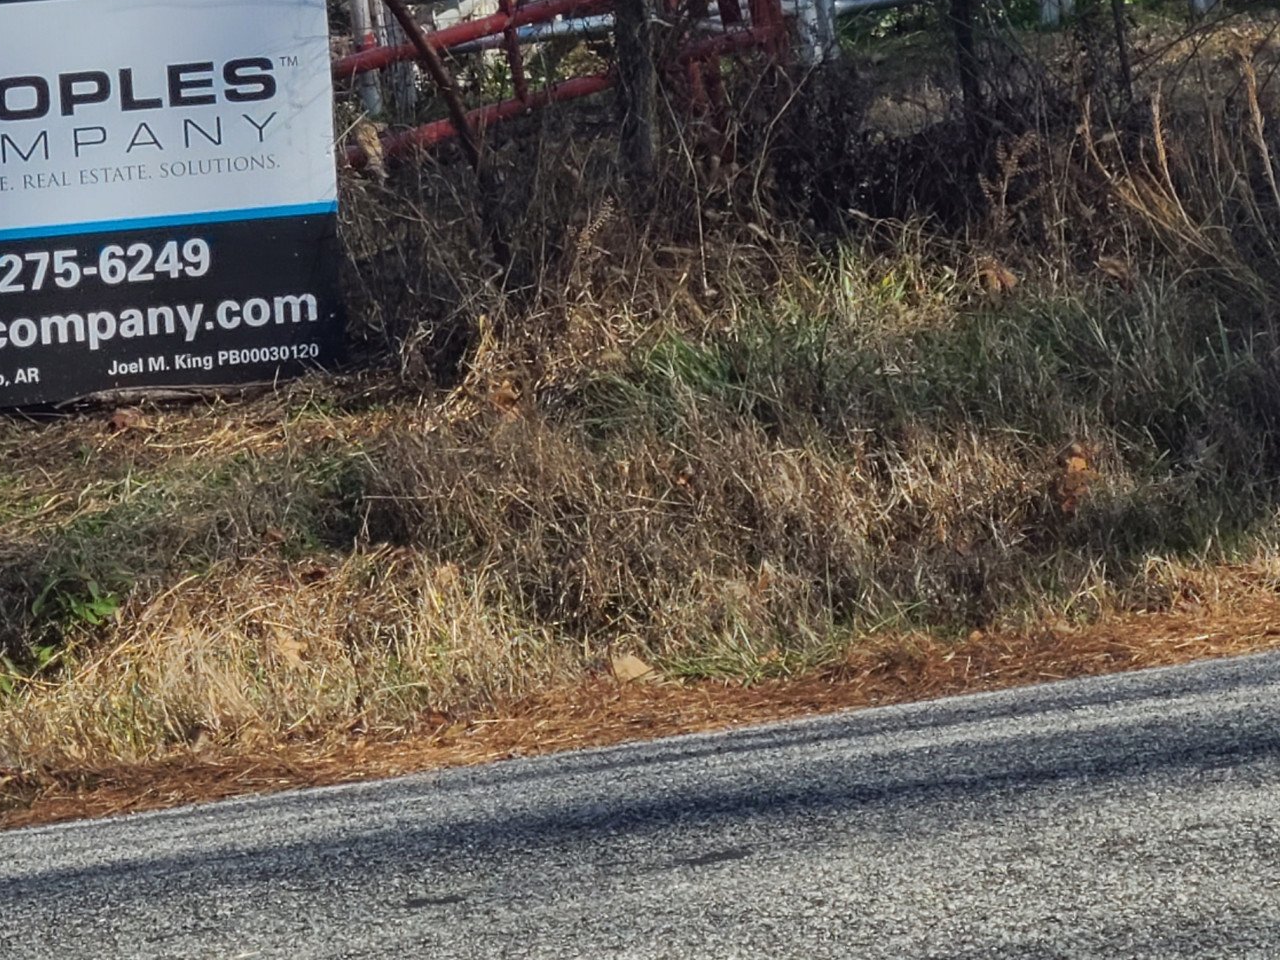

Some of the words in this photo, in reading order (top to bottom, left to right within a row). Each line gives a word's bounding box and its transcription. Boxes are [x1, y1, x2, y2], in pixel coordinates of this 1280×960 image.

[22, 171, 71, 189] REAL
[78, 163, 152, 186] ESTATE.
[159, 153, 281, 179] SOLUTIONS.
[14, 367, 40, 384] AR
[107, 358, 144, 376] Joel
[148, 356, 170, 372] M.
[174, 353, 213, 370] King
[218, 342, 319, 366] PB00030120
